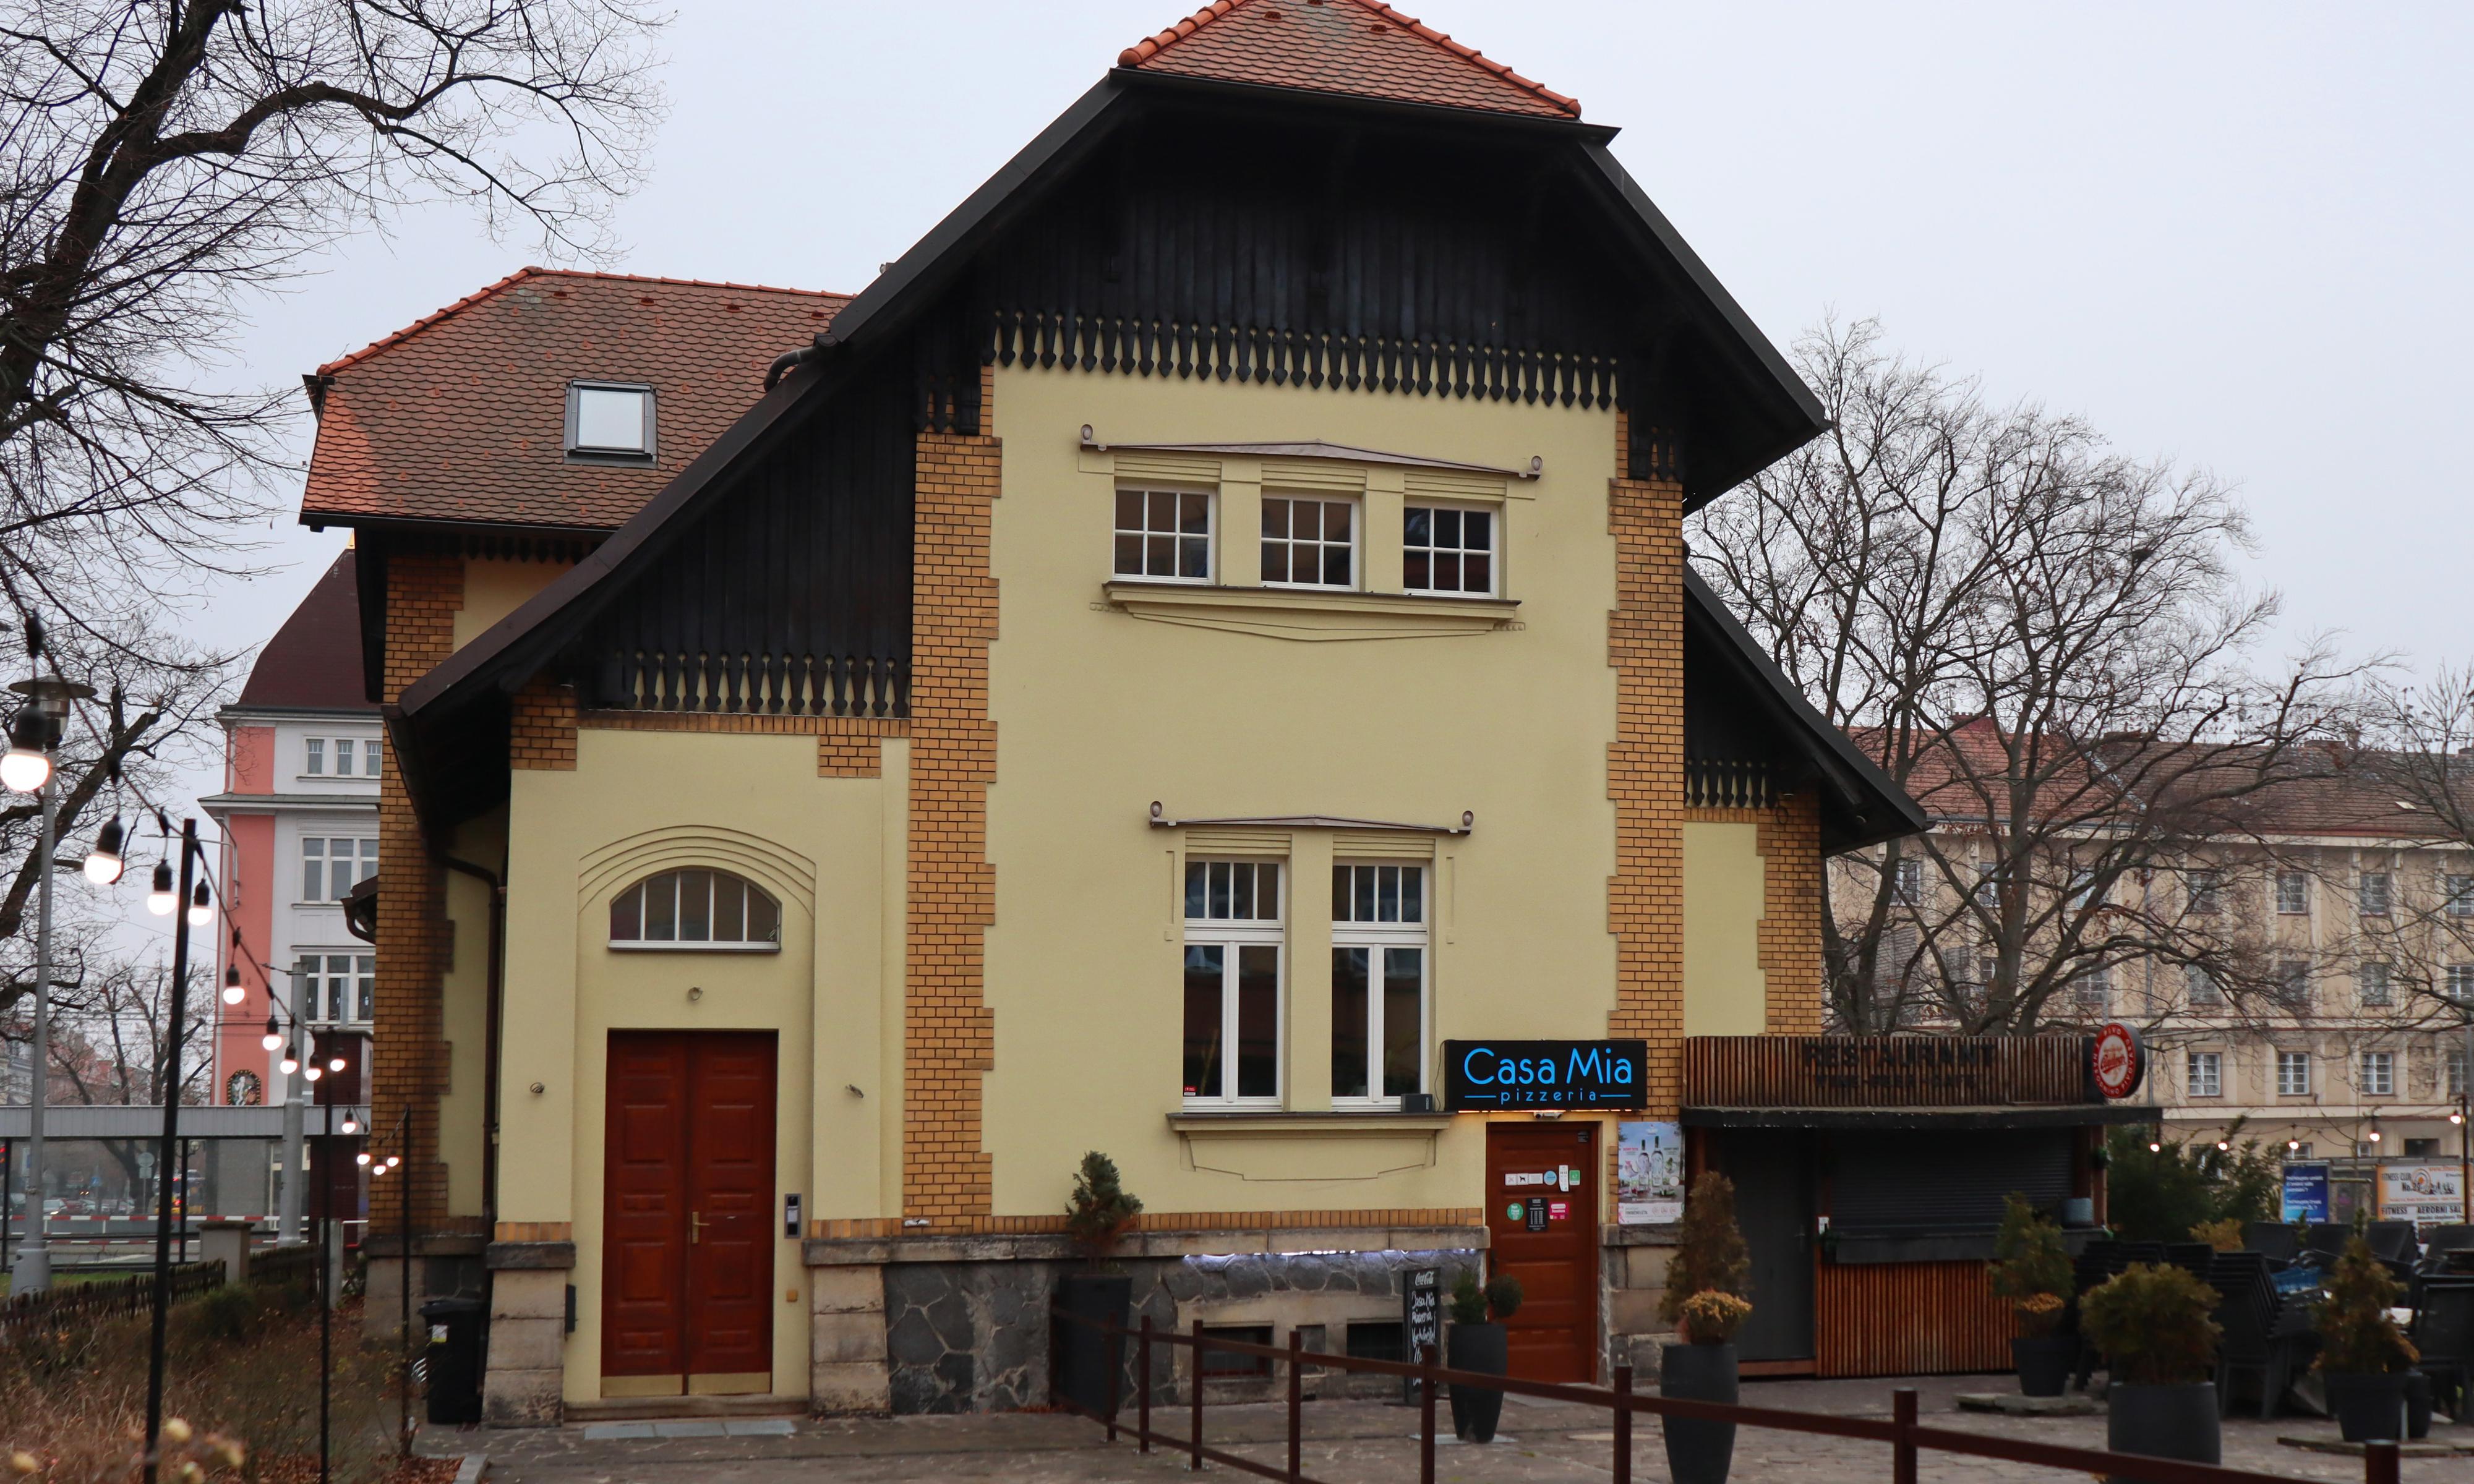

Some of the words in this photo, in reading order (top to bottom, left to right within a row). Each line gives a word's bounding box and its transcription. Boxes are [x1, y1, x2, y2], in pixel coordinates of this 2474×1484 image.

[1465, 1048, 1555, 1084] Casa
[1567, 1048, 1631, 1083] Mia
[1806, 1043, 1993, 1067] RESTAURANT
[1501, 1089, 1595, 1104] pizzeria
